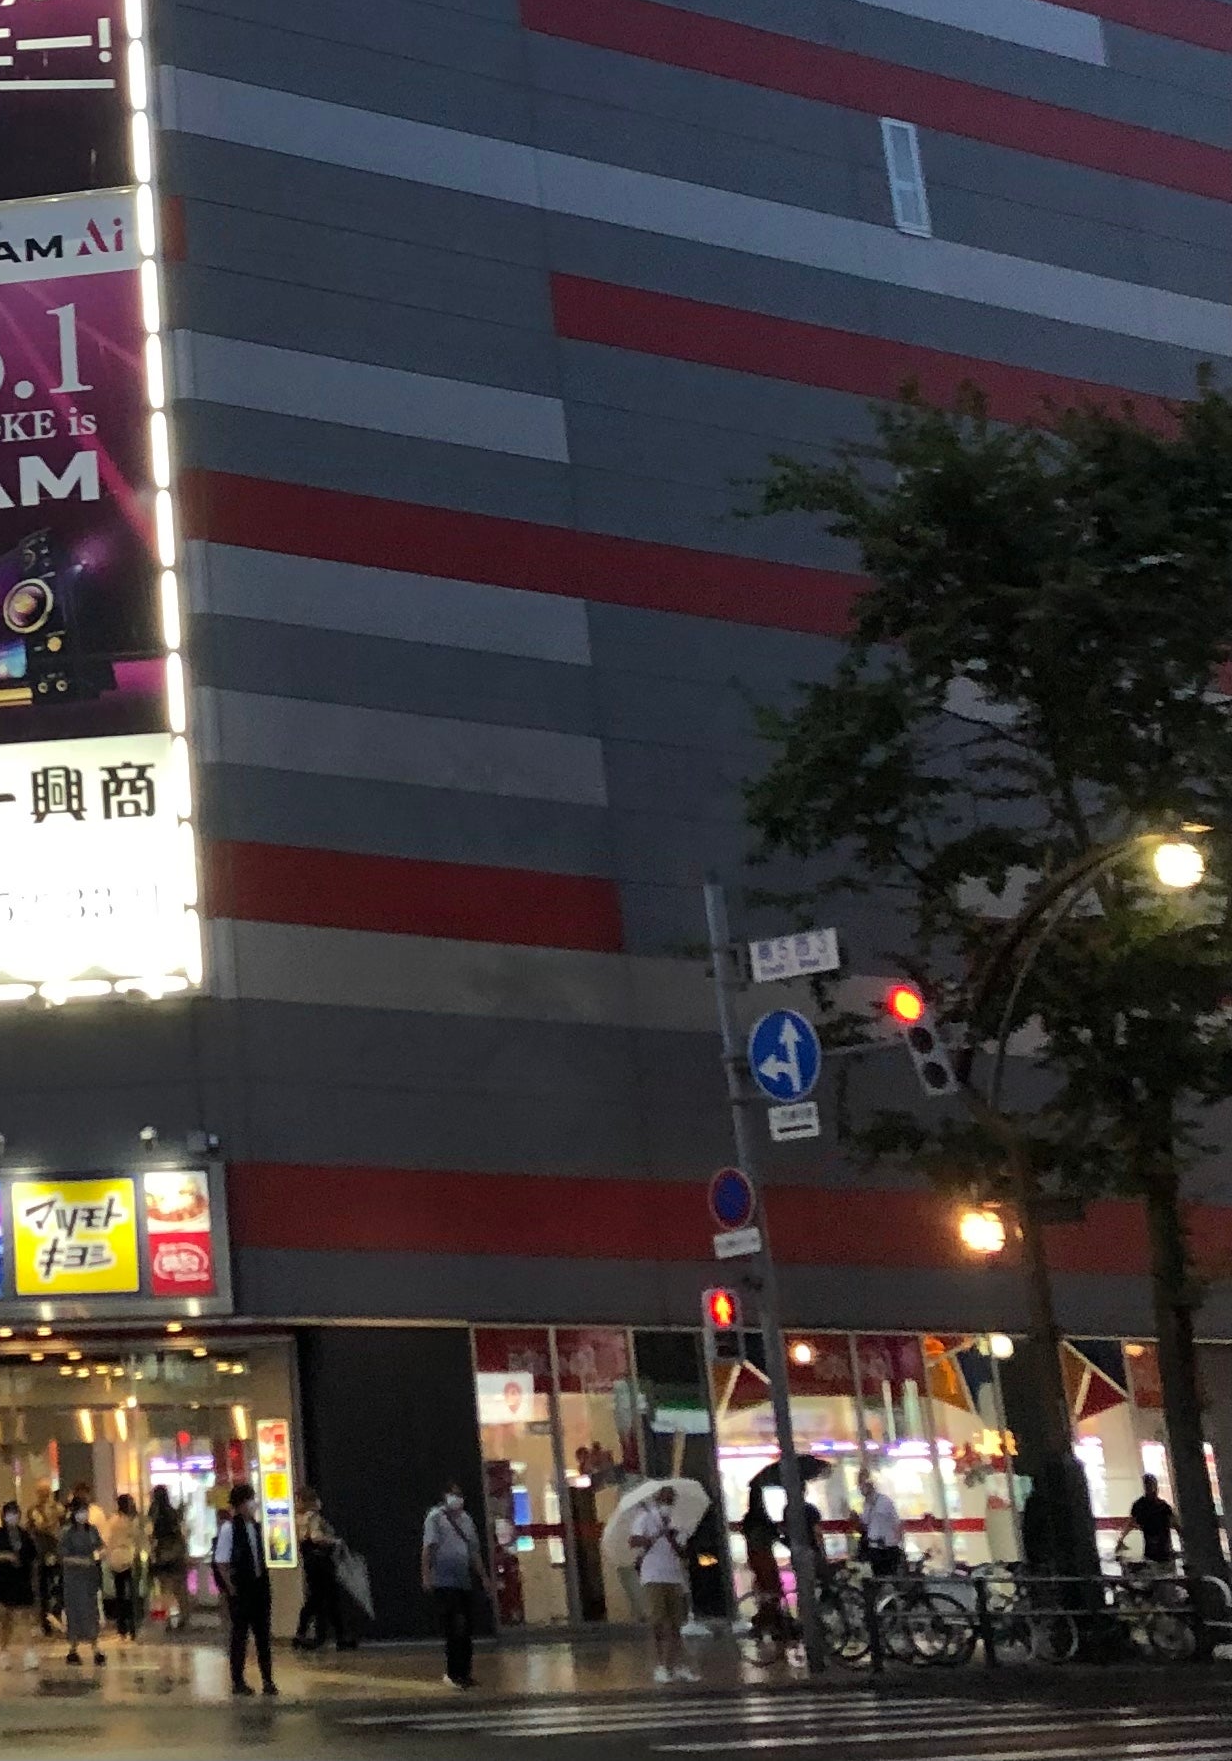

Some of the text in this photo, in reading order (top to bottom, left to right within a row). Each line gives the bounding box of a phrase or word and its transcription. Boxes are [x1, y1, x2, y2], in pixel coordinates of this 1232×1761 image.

[68, 406, 98, 437] is
[26, 1195, 122, 1239] マツモト
[39, 1237, 112, 1279] キヨシ
